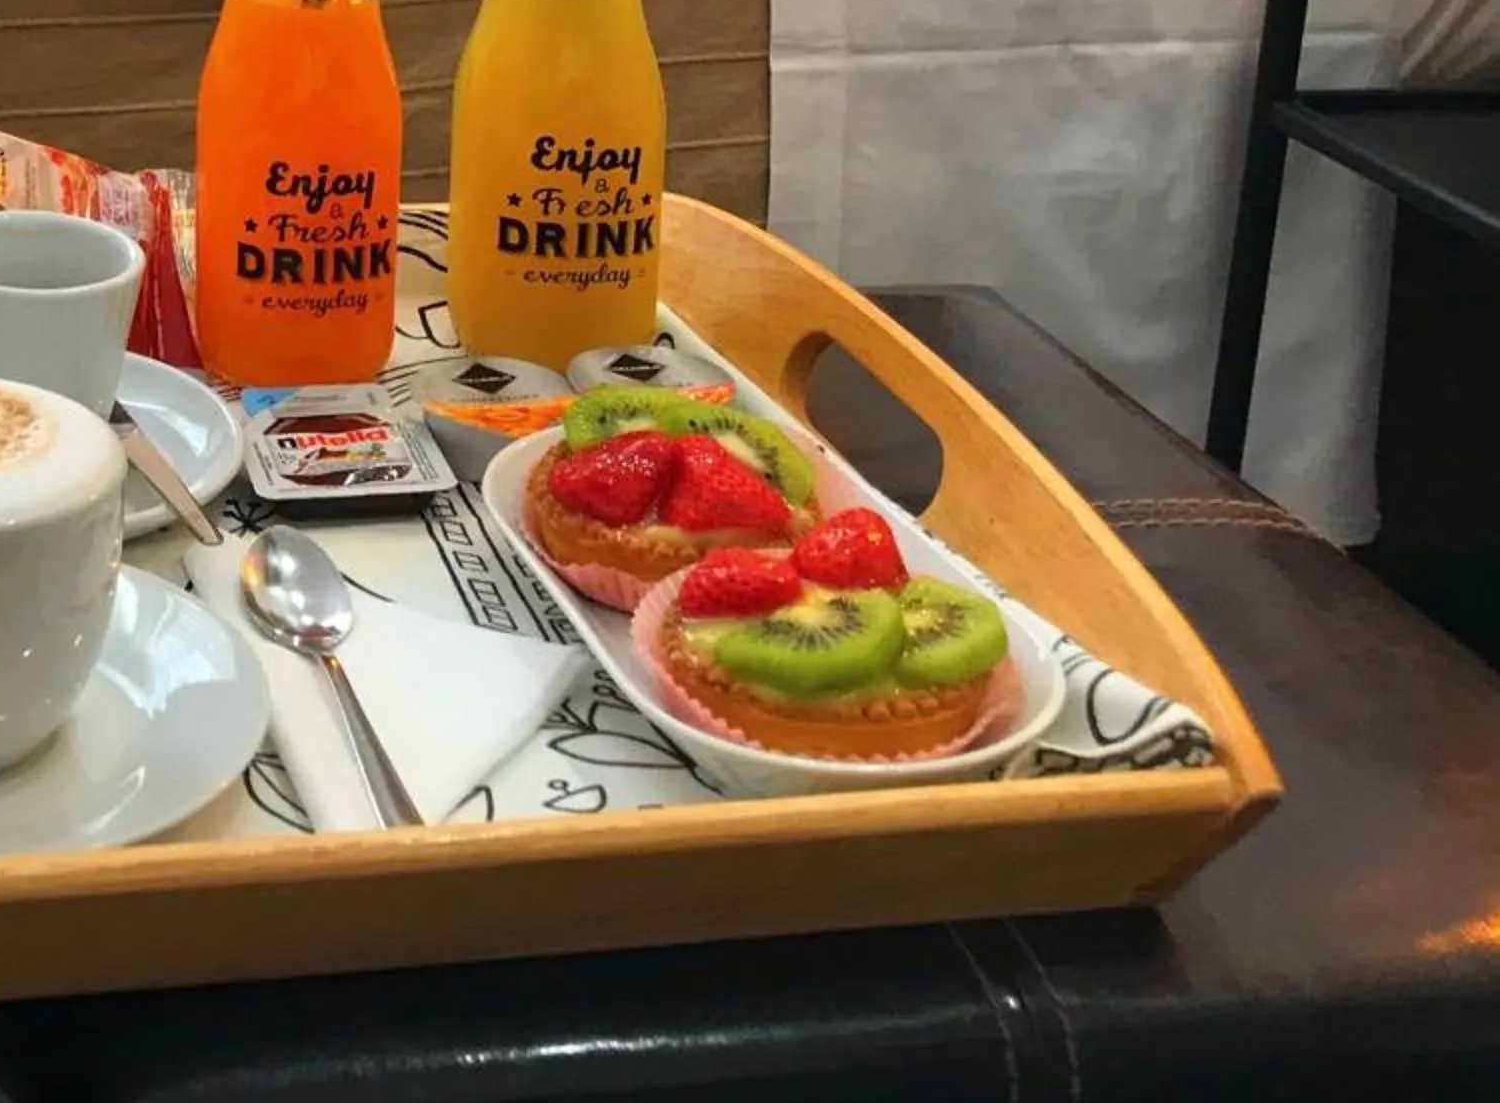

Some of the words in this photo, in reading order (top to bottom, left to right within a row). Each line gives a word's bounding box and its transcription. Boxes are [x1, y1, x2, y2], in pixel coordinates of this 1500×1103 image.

[531, 136, 641, 185] Enjoy
[265, 162, 376, 214] Enjoy
[532, 186, 634, 216] Fresh
[594, 178, 609, 194] a
[331, 203, 344, 218] a
[268, 212, 369, 242] Fresh
[496, 215, 654, 259] DRINK
[237, 238, 392, 285] DRINK
[524, 265, 631, 290] everyday
[262, 291, 370, 317] everyday
[277, 427, 388, 450] nutella
